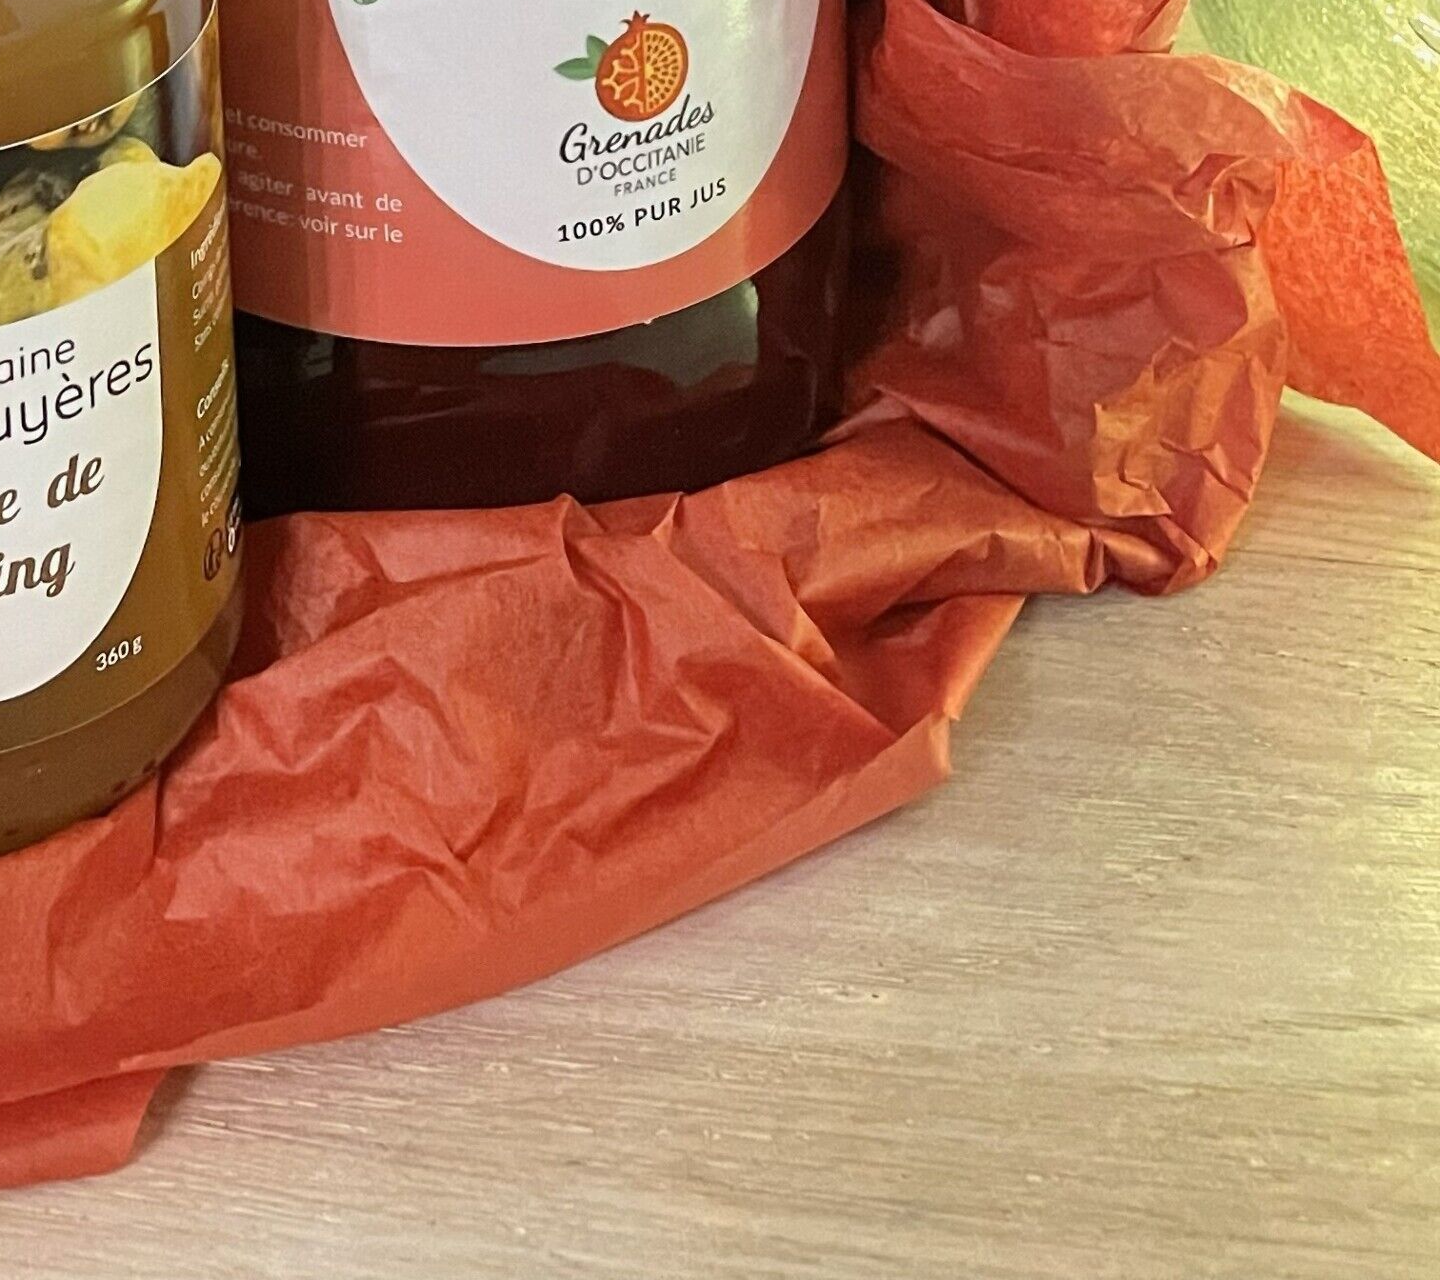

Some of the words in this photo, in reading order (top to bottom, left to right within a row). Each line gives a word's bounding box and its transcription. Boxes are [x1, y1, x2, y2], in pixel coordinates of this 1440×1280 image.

[247, 114, 367, 147] consommer
[559, 94, 715, 164] Grenades
[576, 133, 706, 186] D'OCCITANIE
[306, 186, 363, 208] avant
[375, 193, 403, 212] de
[614, 167, 677, 198] FRANCE
[557, 212, 625, 243] 100%
[634, 198, 682, 227] PUR
[689, 177, 727, 209] JUS
[299, 215, 338, 234] voir
[345, 223, 377, 240] sur
[384, 224, 403, 243] le
[47, 452, 105, 509] de
[96, 640, 130, 671] 360
